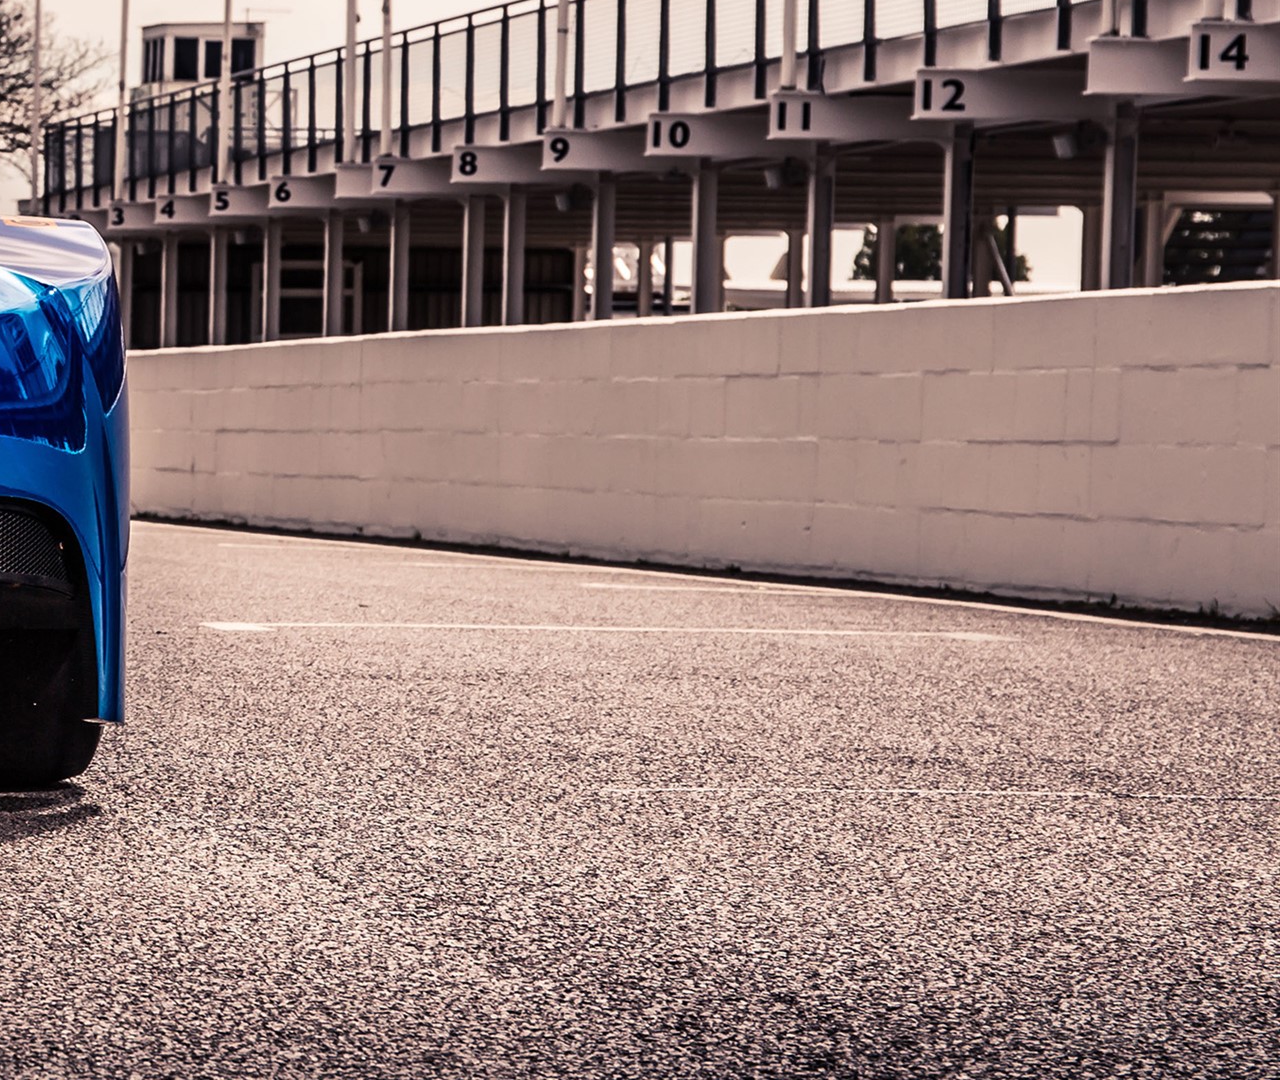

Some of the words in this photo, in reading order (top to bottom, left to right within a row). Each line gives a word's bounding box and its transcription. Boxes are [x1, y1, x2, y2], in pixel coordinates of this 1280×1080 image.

[1199, 33, 1249, 70] 14
[922, 78, 966, 111] 12
[777, 101, 811, 131] 11
[652, 121, 690, 148] 10
[549, 137, 570, 163] 9
[378, 164, 395, 187] 7
[458, 151, 478, 176] 8
[214, 191, 229, 211] 5
[275, 181, 291, 202] 6
[111, 207, 125, 226] 3
[159, 199, 175, 219] 4
